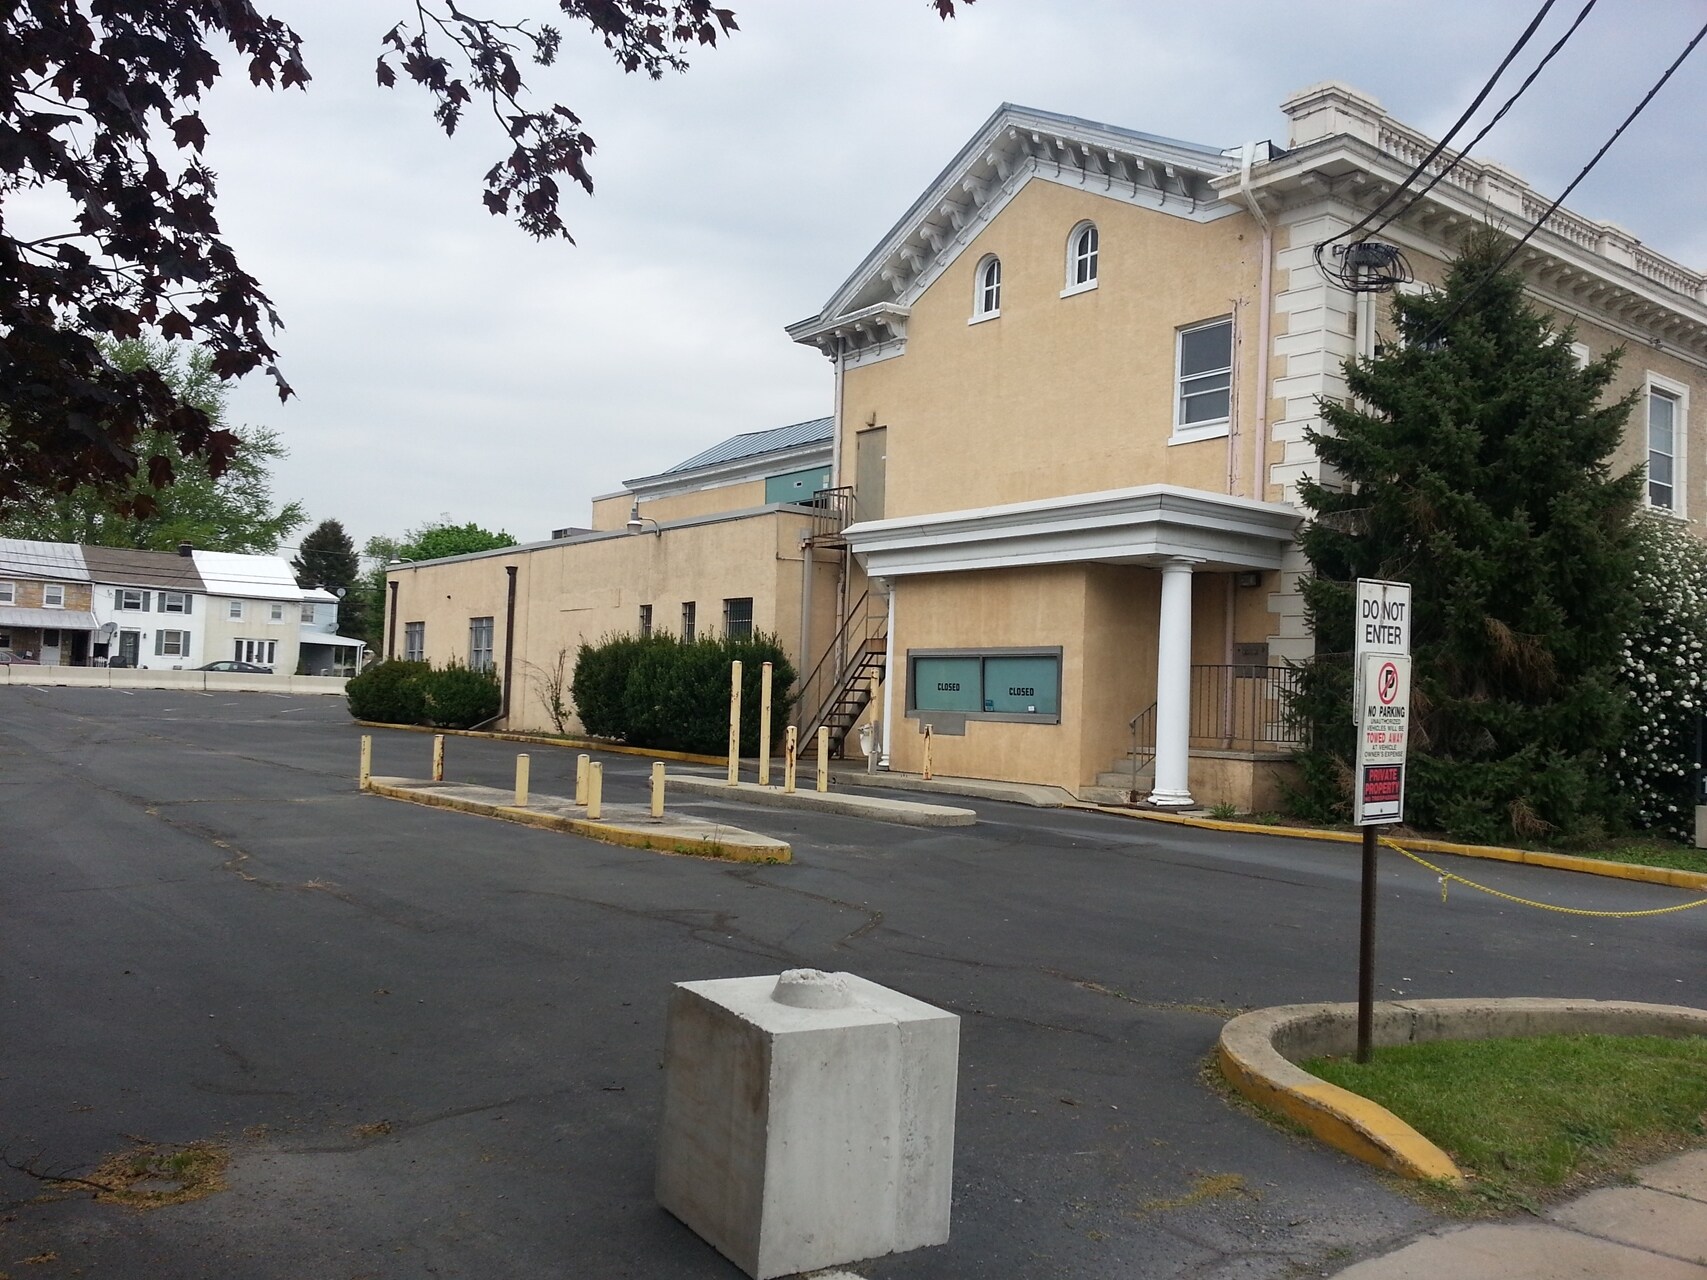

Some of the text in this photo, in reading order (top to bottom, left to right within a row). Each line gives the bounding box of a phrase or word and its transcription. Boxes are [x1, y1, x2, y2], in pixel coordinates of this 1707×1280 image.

[1362, 600, 1405, 621] DO NOT
[1366, 624, 1401, 645] ENTER
[938, 683, 960, 691] CLOSED
[1009, 688, 1034, 696] CLOSED
[1368, 705, 1405, 717] NO PARKING
[1367, 732, 1403, 743] TOWED AWAY
[1369, 768, 1397, 781] PRIVATE
[1365, 781, 1399, 794] PROPERTY
